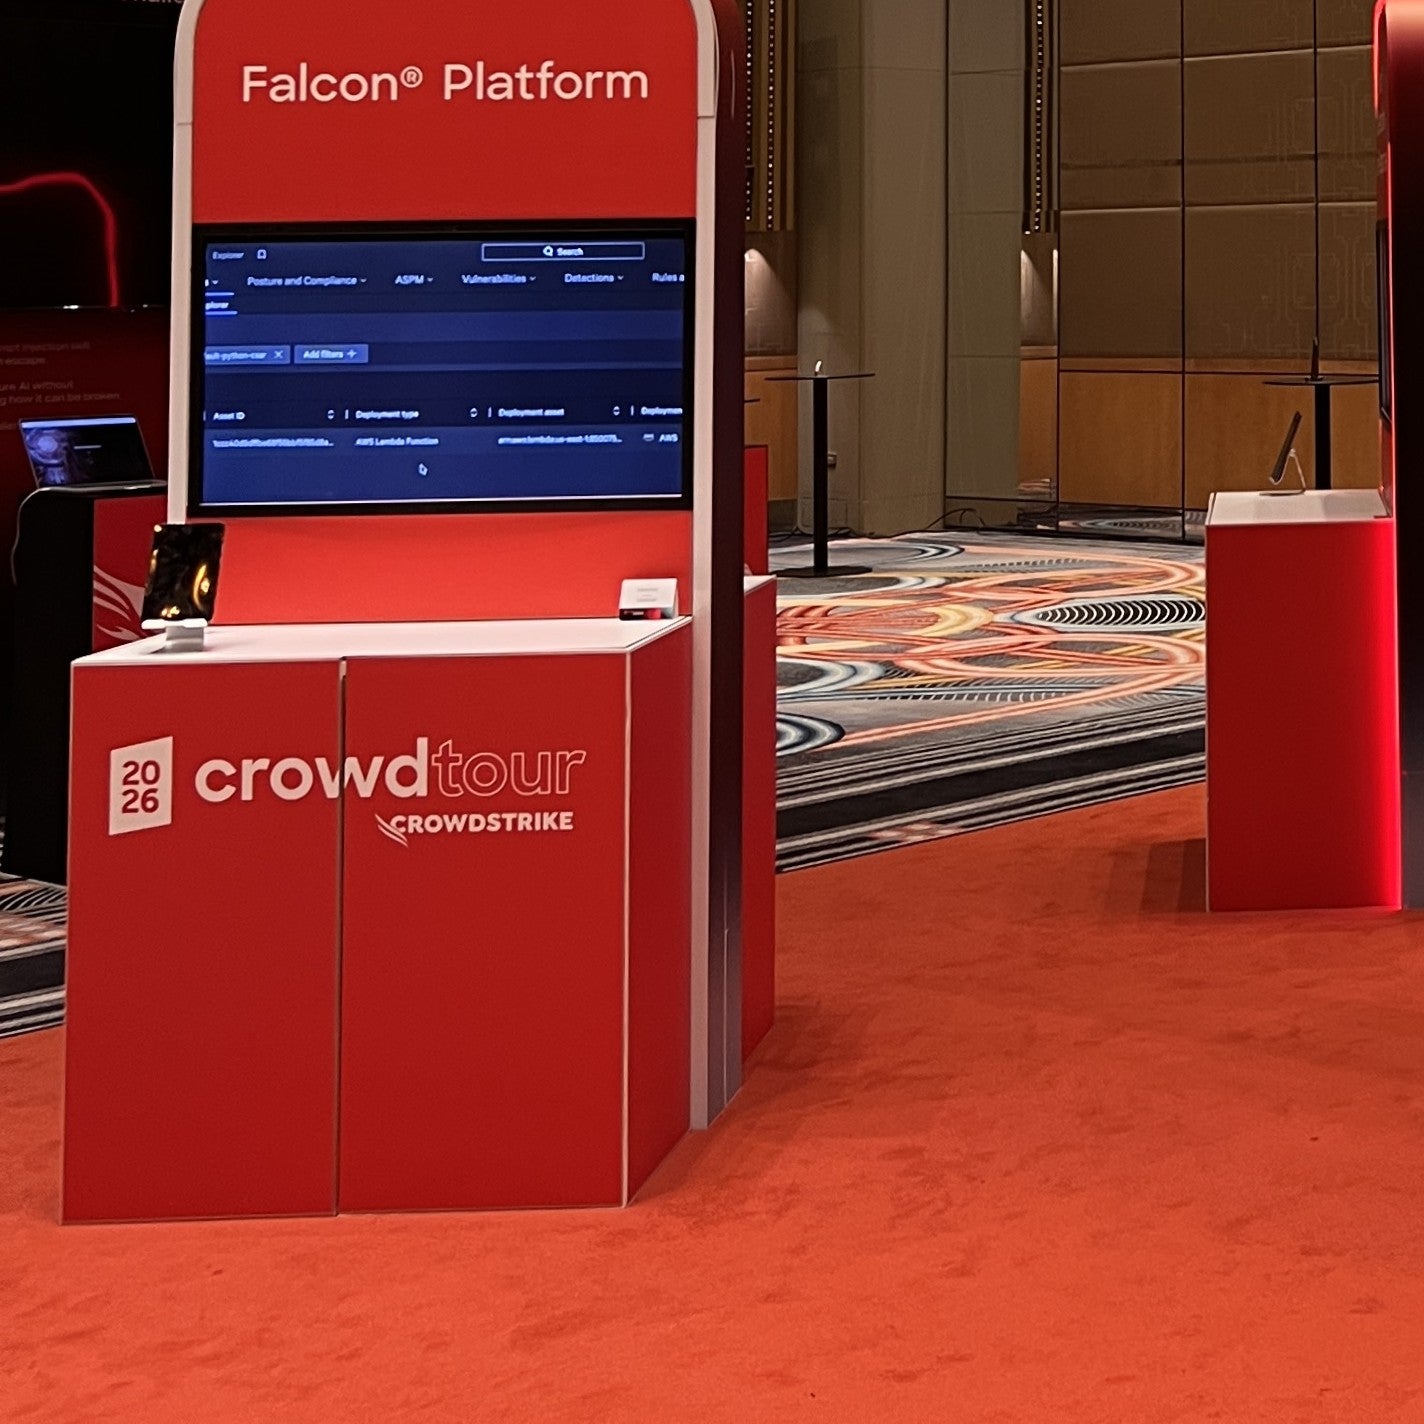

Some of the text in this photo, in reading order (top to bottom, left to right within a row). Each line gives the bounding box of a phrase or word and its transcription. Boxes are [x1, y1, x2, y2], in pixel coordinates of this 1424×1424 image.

[242, 61, 648, 102] Falcon® Platform
[247, 275, 357, 287] Posture and Compliance
[395, 275, 424, 285] ASPM
[461, 274, 527, 284] Vulnerabilities
[564, 273, 615, 283] Detections
[122, 737, 586, 803] 20 crowdtour
[121, 788, 160, 814] 26
[389, 811, 573, 835] CROWDSTRIKE
